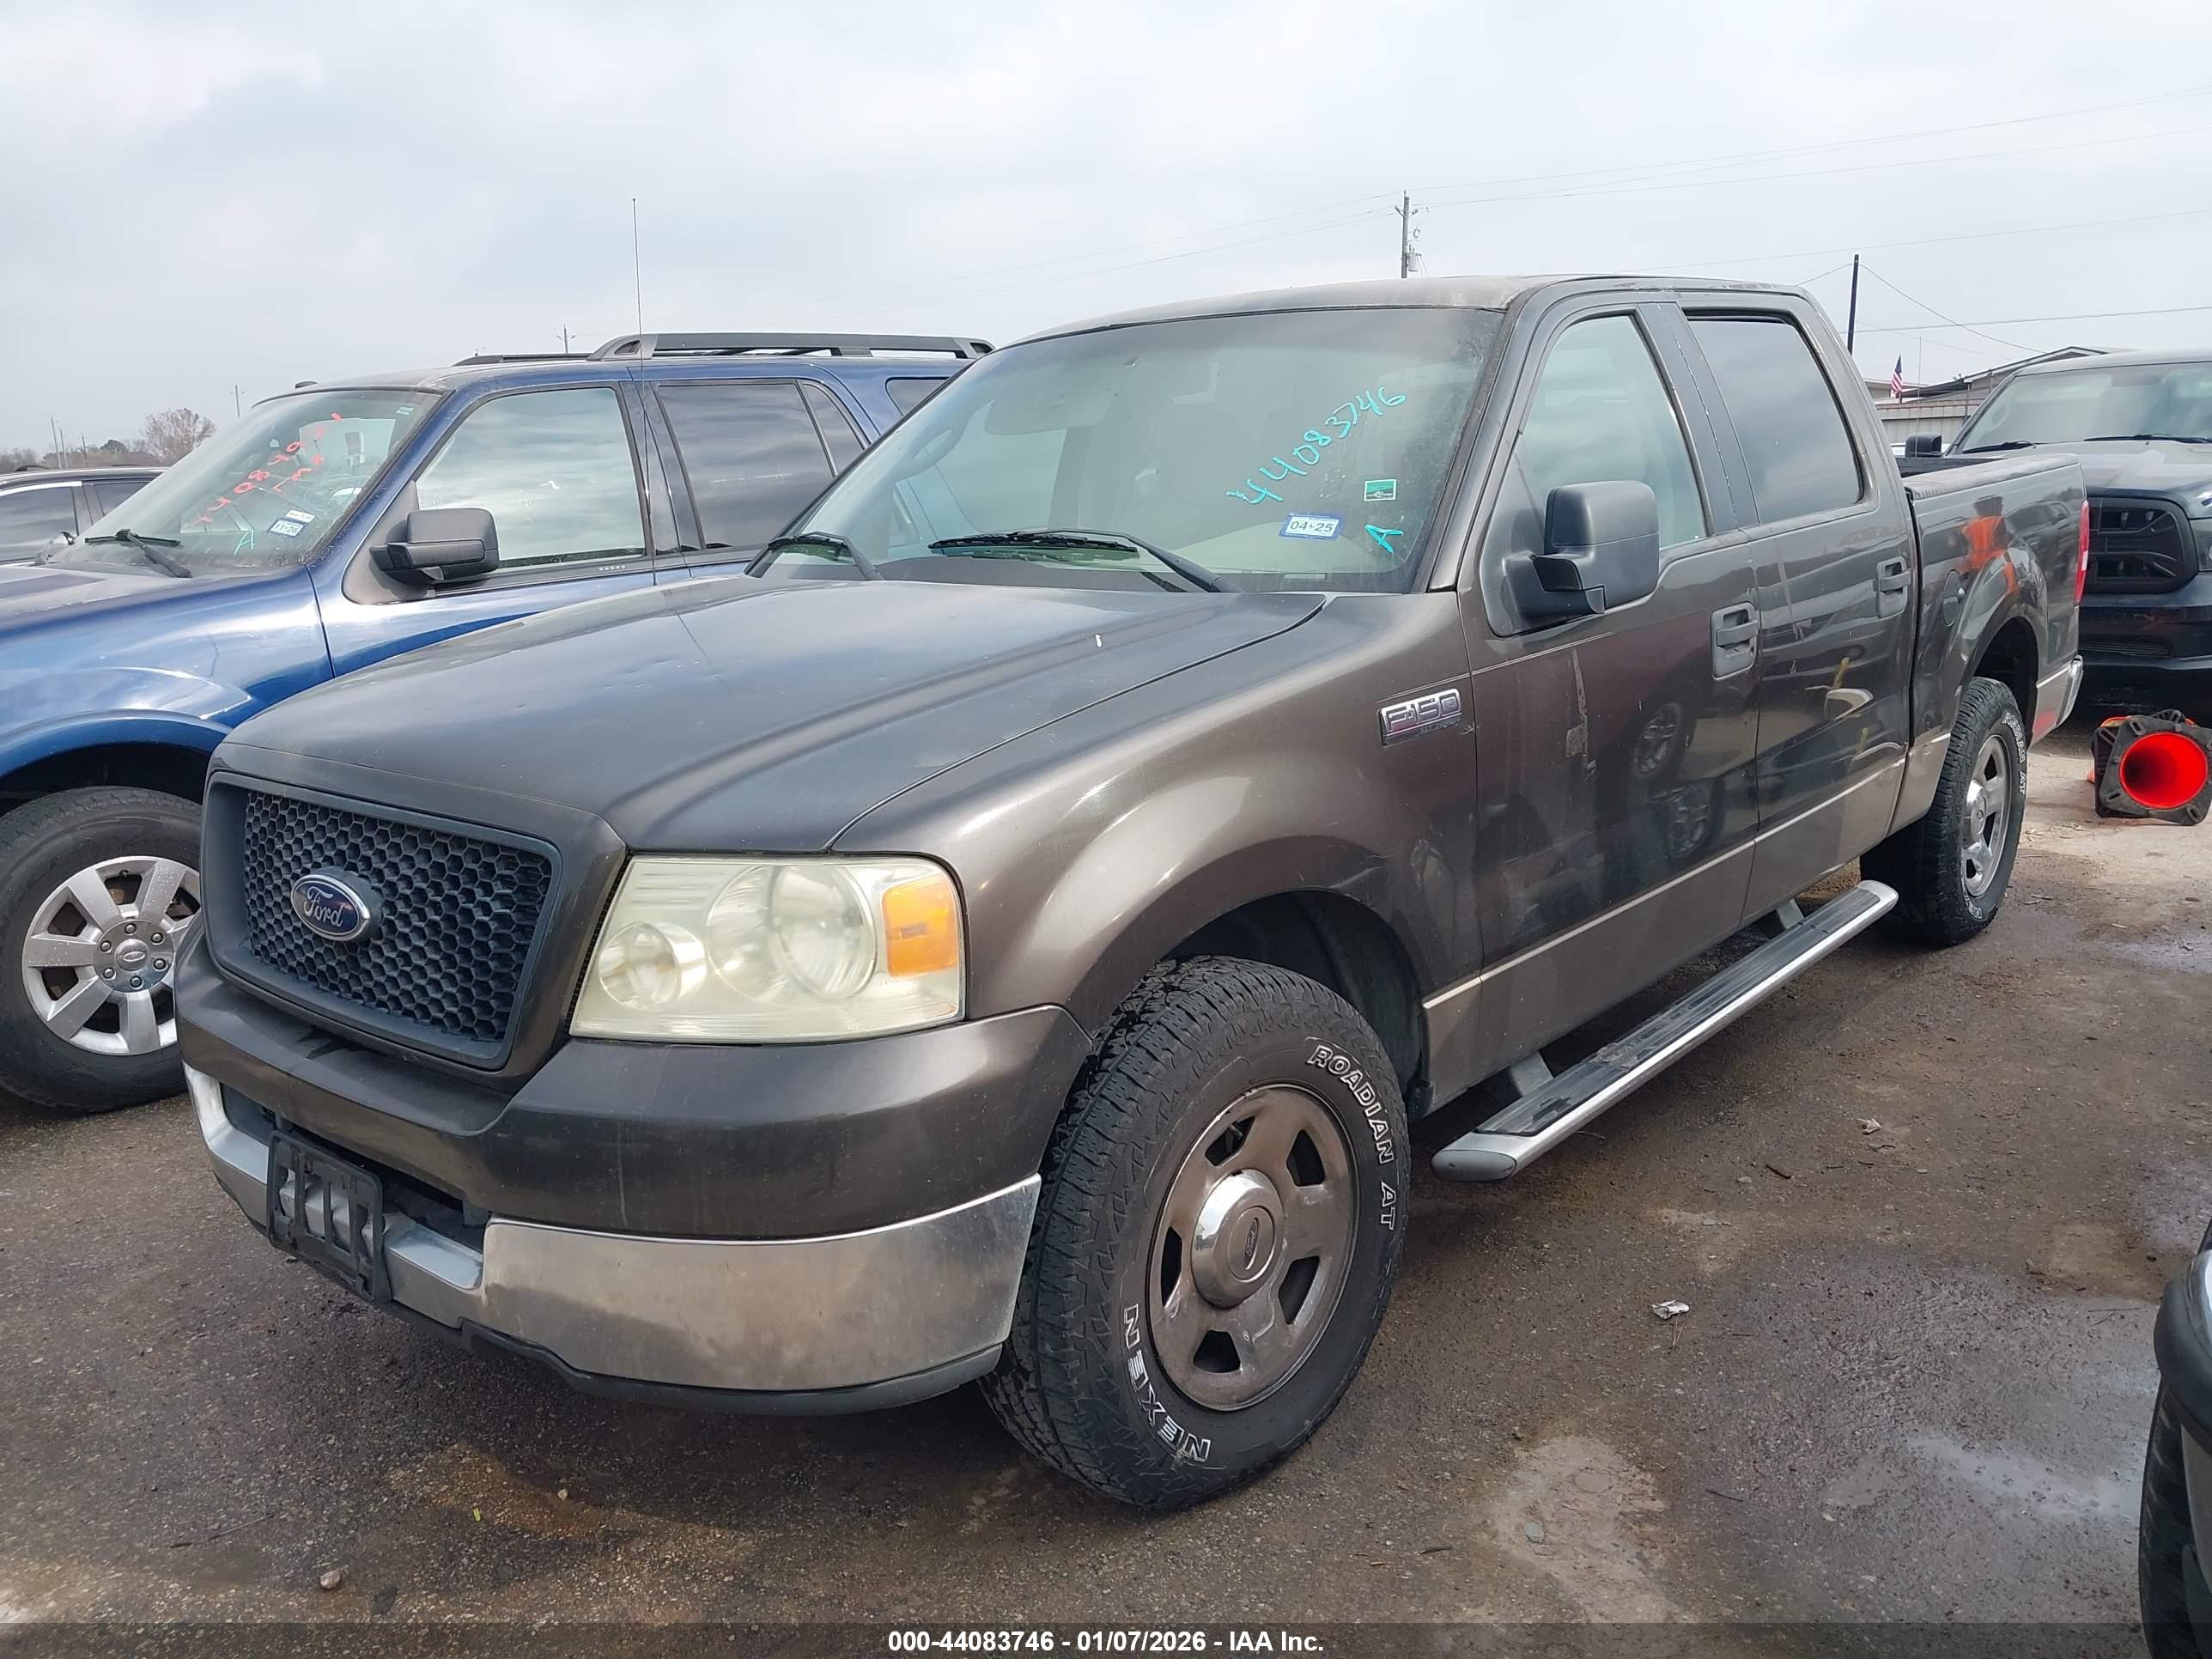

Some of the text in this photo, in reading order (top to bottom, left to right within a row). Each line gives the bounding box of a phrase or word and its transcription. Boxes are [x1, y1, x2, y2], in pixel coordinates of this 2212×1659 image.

[1226, 386, 1406, 504] 44083746
[1364, 524, 1403, 554] A
[303, 885, 344, 927] Ford
[1305, 1044, 1396, 1231] ROADIAN AT
[1123, 1303, 1212, 1462] NEXEN
